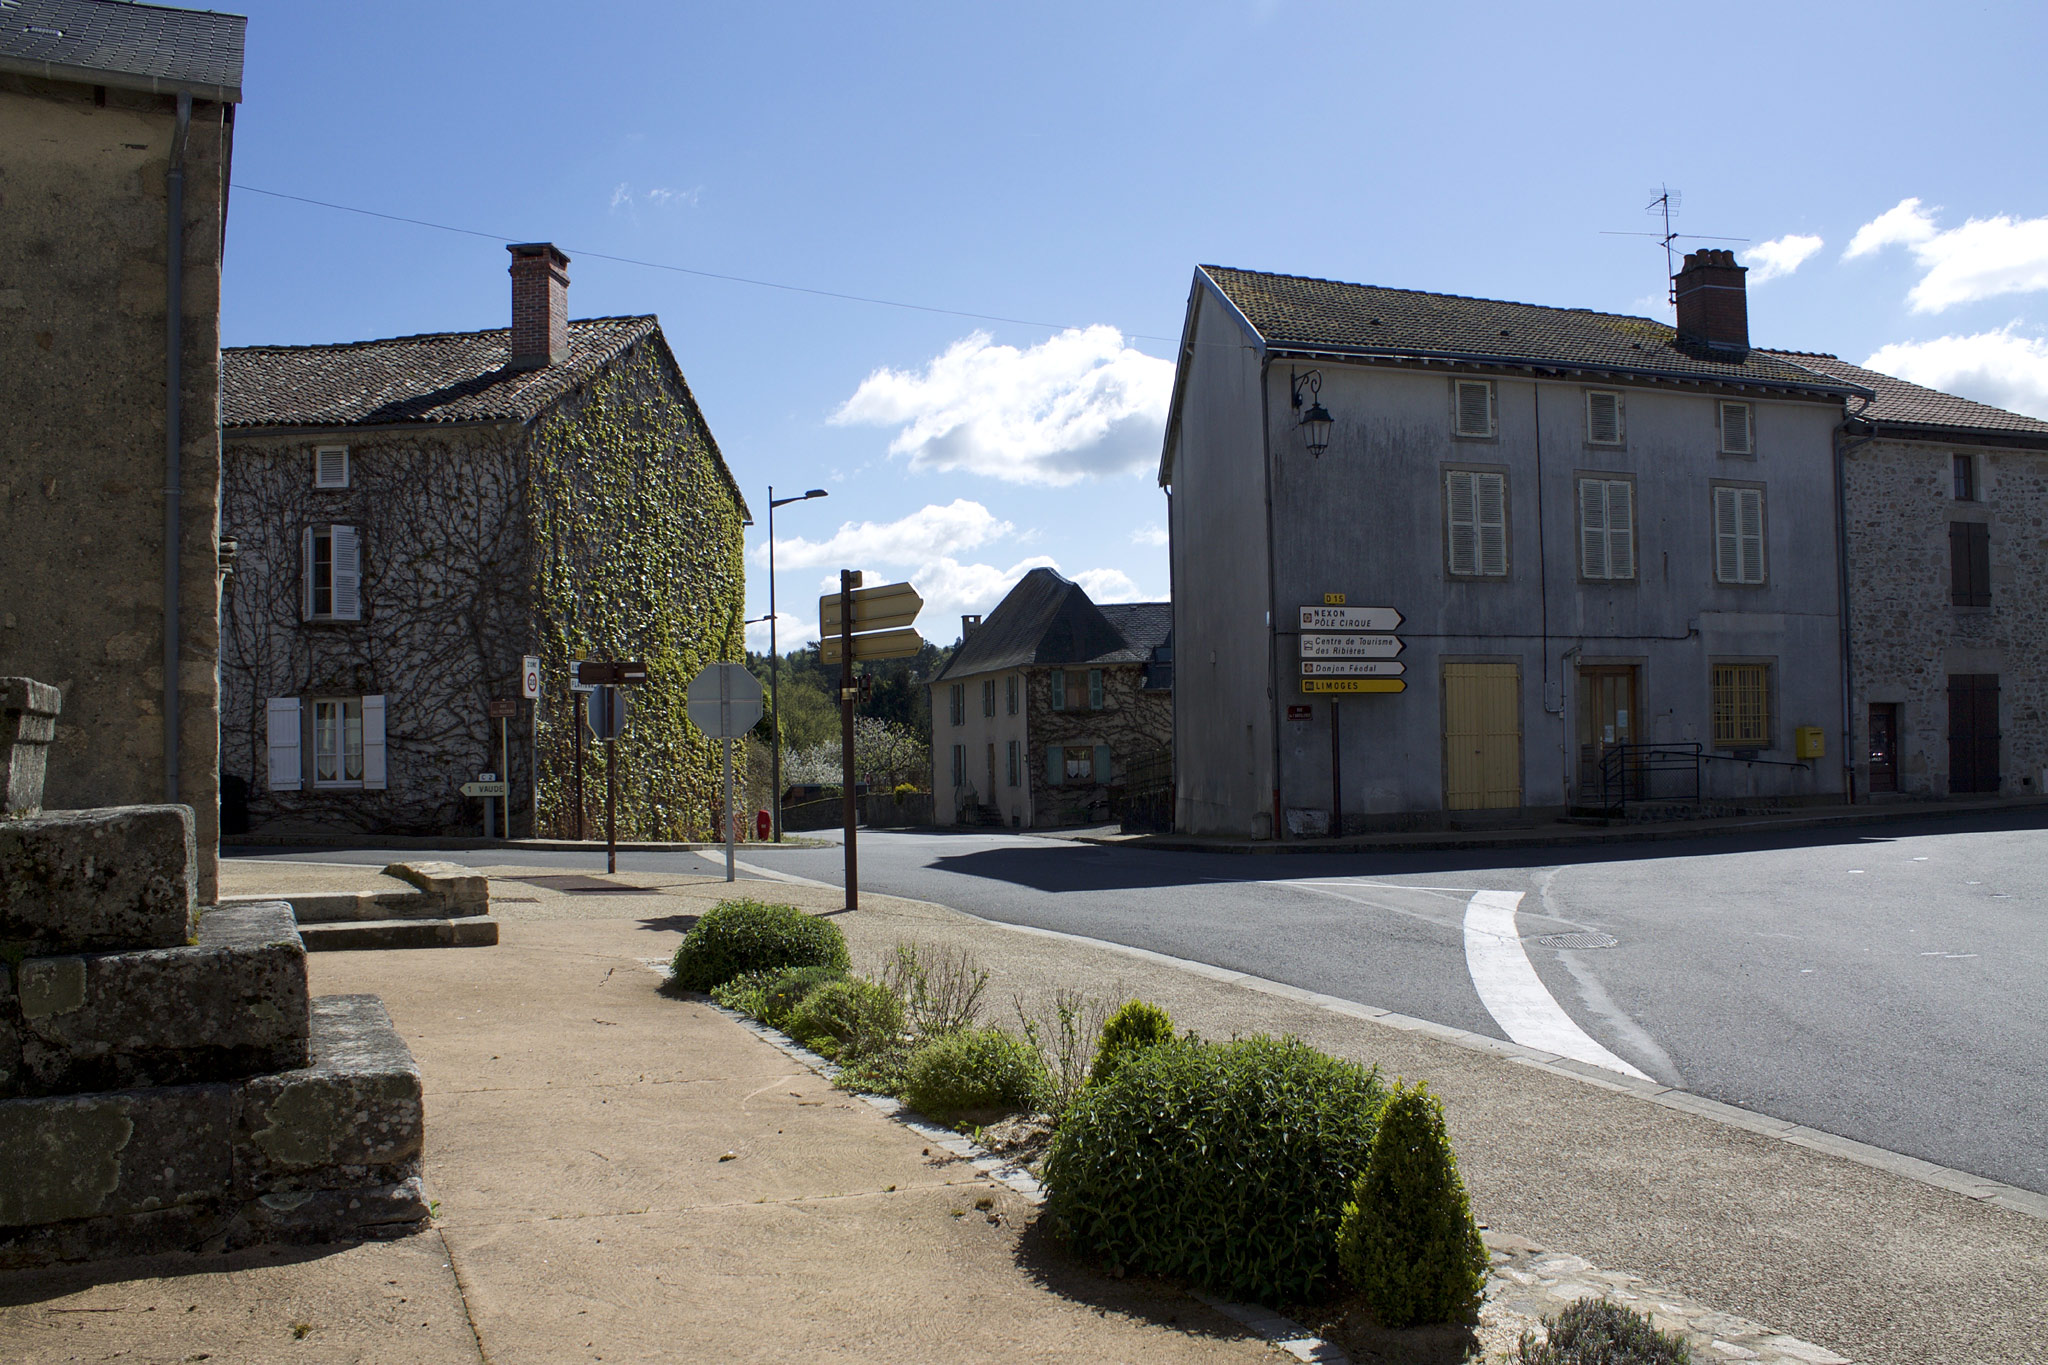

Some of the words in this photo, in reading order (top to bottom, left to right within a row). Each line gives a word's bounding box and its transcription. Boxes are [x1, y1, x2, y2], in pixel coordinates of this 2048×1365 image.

[1334, 595, 1344, 603] 15
[1314, 609, 1345, 617] NEXON
[1314, 617, 1335, 627] PÔLE
[1339, 619, 1372, 627] CIRQUE
[1315, 637, 1342, 645] Centre
[1345, 637, 1355, 645] de
[1359, 637, 1393, 646] Tourisme
[1315, 647, 1329, 655] des
[1333, 646, 1366, 655] Ribières
[1315, 664, 1345, 673] Donjon
[1348, 664, 1377, 672] Féodal
[1315, 682, 1358, 690] LIMOGES
